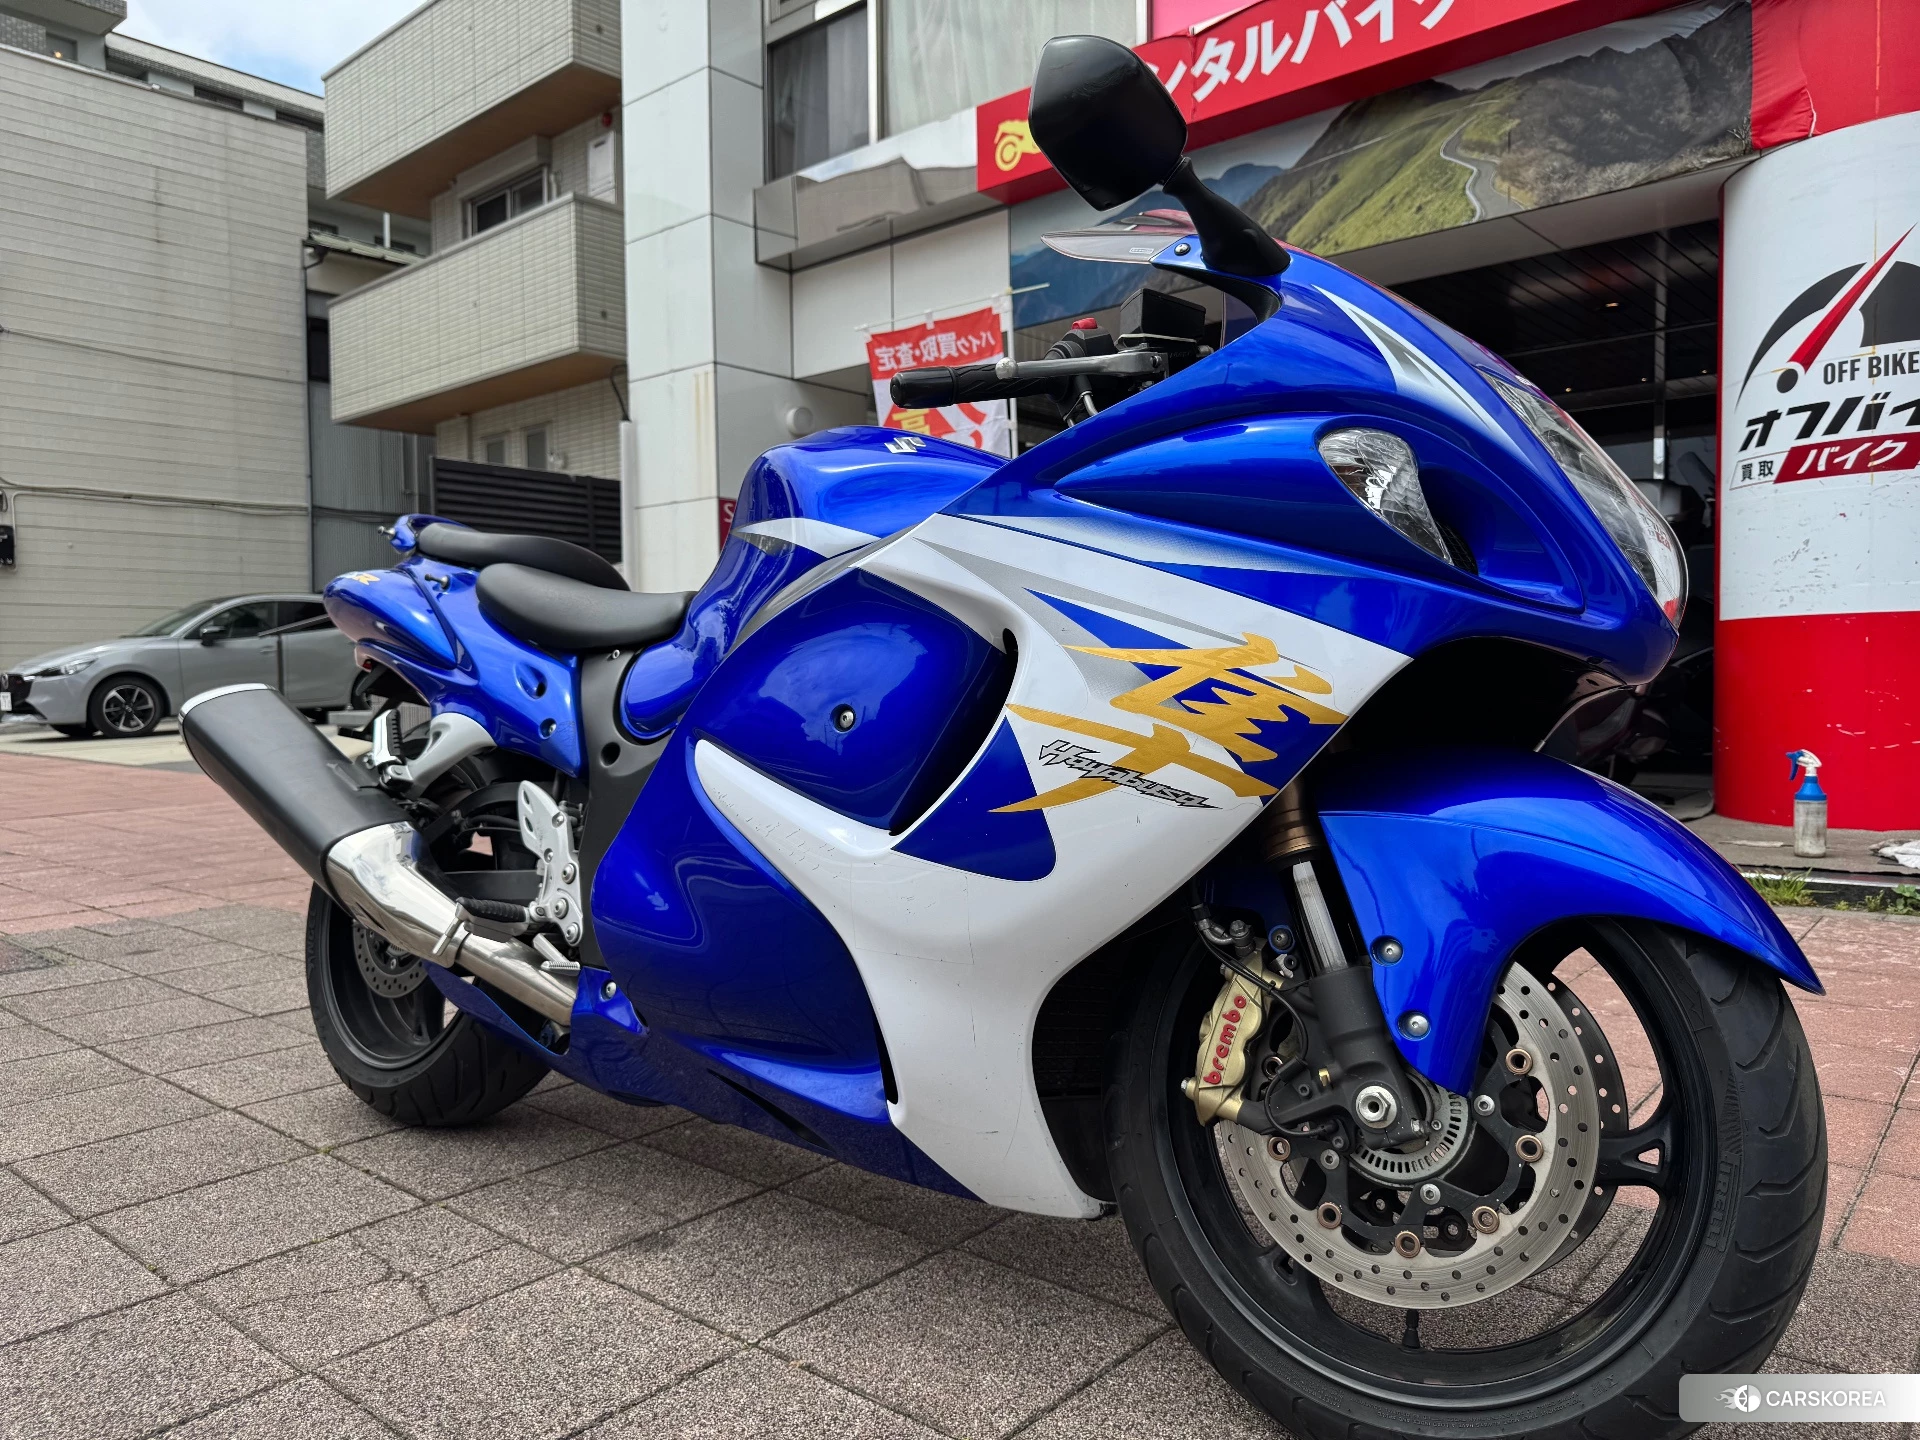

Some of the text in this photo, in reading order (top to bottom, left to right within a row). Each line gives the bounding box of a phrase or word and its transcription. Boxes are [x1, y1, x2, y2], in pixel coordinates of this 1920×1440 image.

[1823, 351, 1920, 385] OFF BIKE
[1740, 440, 1908, 482] 買取 バイク
[1203, 995, 1247, 1085] brembo
